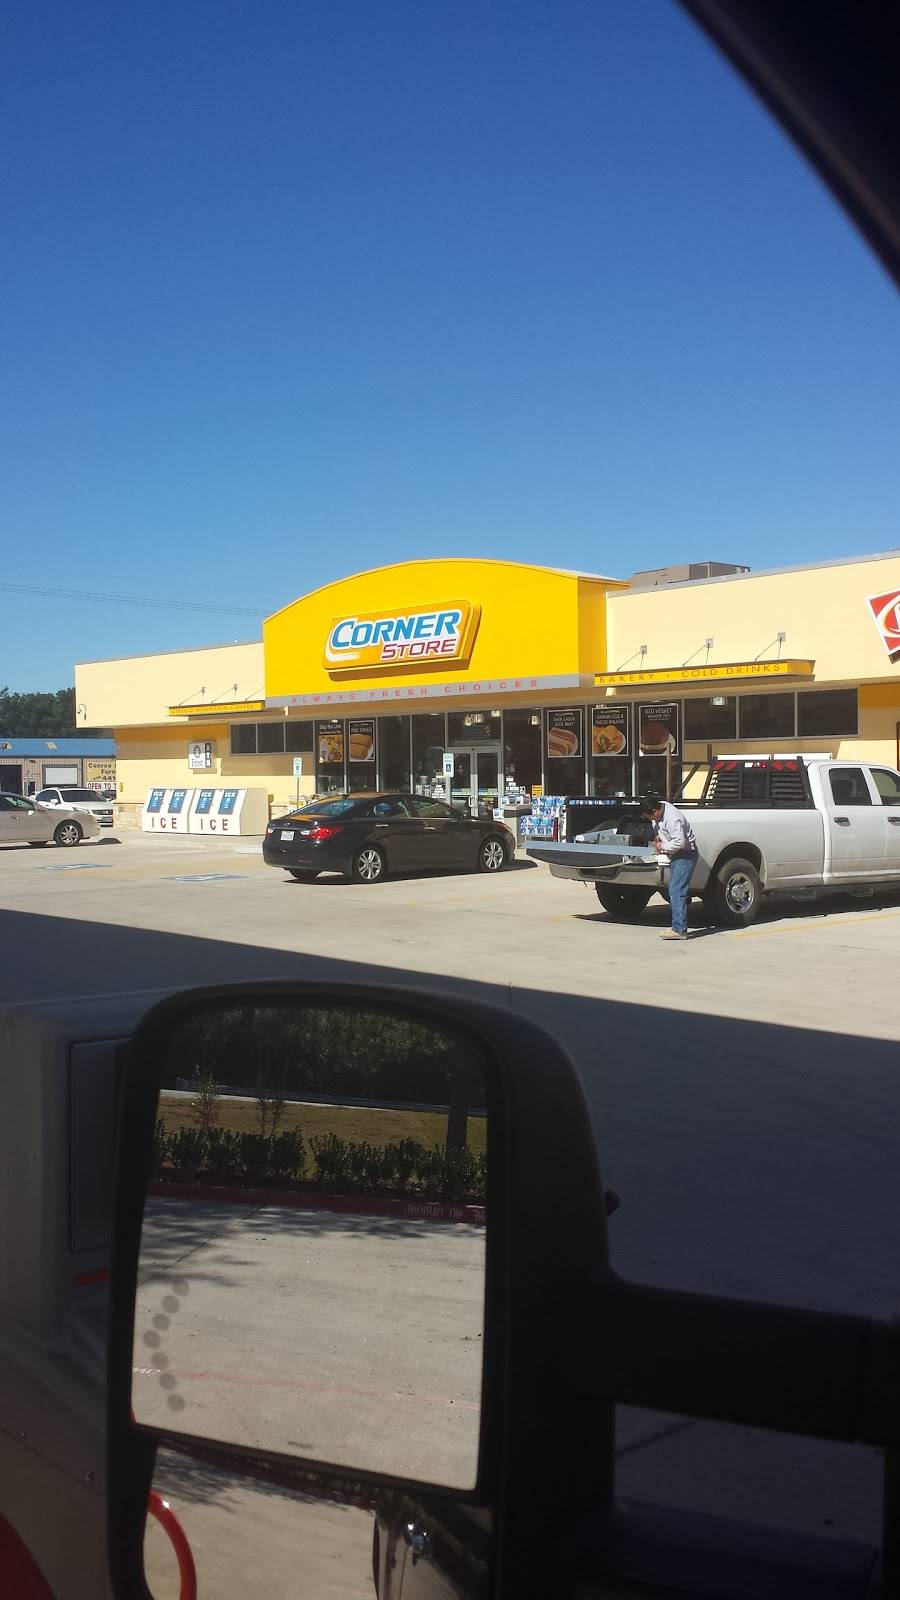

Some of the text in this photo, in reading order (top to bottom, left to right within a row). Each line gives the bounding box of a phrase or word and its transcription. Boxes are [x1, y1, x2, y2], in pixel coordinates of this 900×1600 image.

[331, 611, 460, 648] CORNER
[381, 638, 457, 659] STORE
[599, 663, 781, 684] BAKERY COLD DRINKS
[290, 679, 538, 704] ALWAYS FRESH CHOICES
[87, 782, 102, 790] OPEN
[151, 816, 177, 829] ICE
[200, 818, 229, 831] ICE
